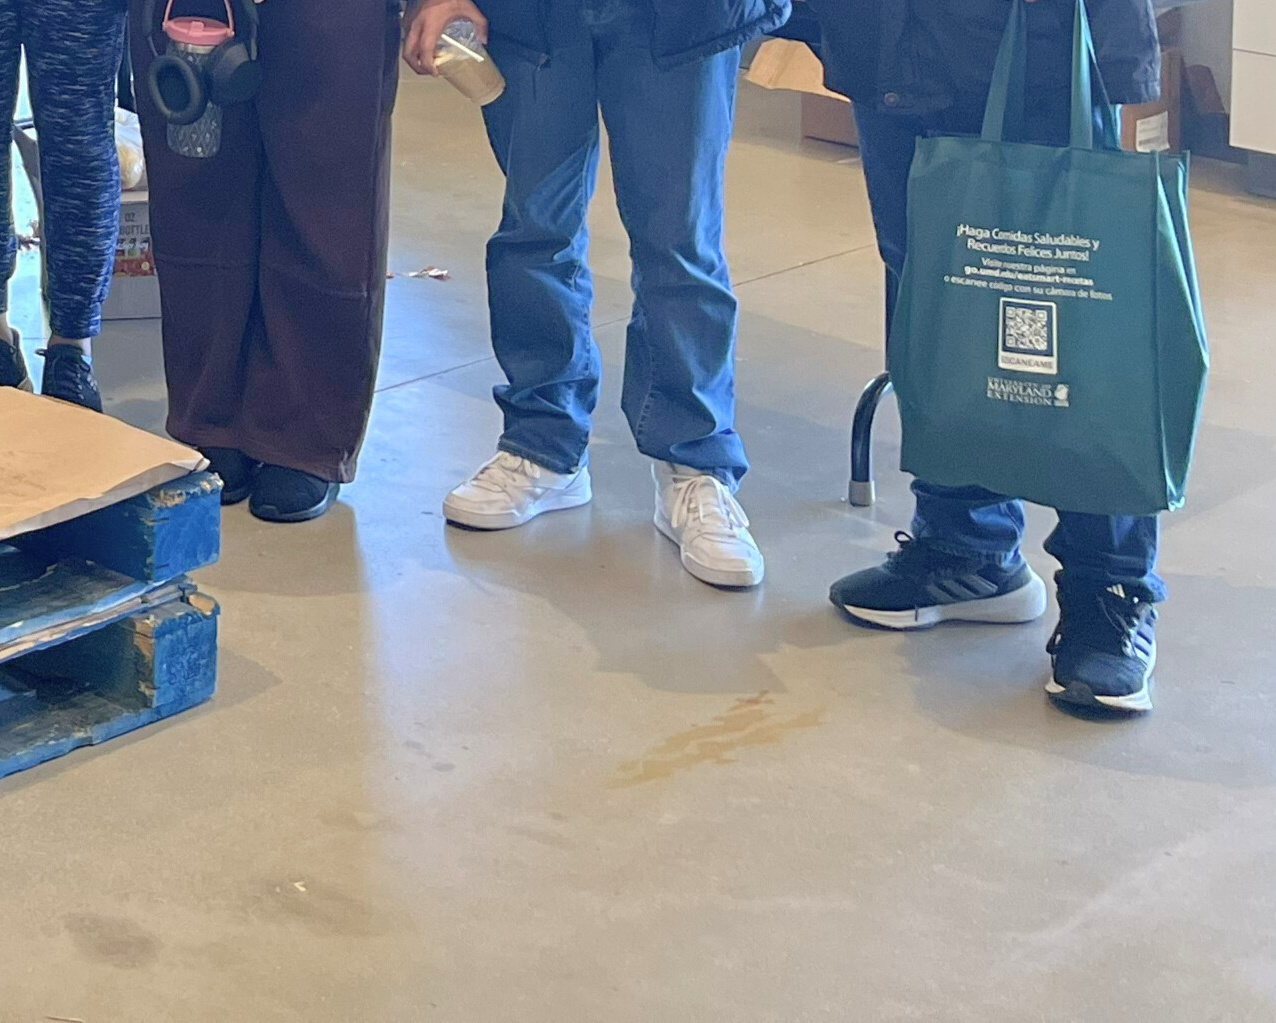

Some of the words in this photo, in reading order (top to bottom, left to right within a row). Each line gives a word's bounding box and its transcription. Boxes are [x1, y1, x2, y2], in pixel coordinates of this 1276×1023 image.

[1091, 238, 1100, 251] y
[987, 389, 1052, 406] EXTENSION
[988, 381, 1052, 398] MARYLAND
